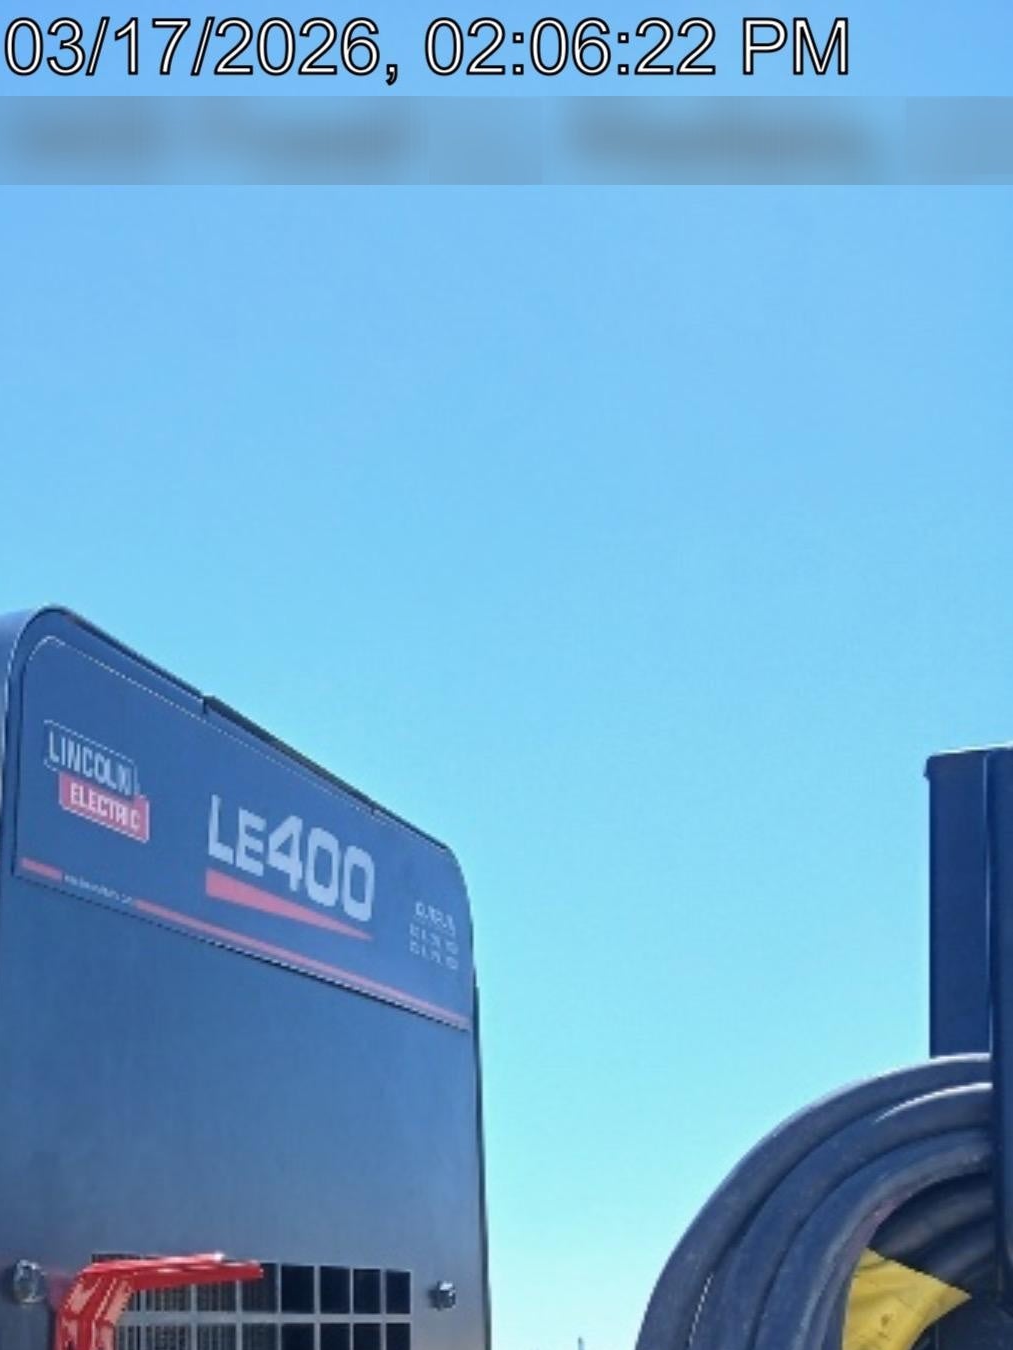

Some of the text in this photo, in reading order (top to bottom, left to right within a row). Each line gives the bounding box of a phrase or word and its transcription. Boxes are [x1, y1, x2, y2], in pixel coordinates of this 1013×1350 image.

[48, 730, 134, 796] LINCOLN
[69, 781, 142, 831] ELECTRIC
[207, 793, 376, 922] LE400
